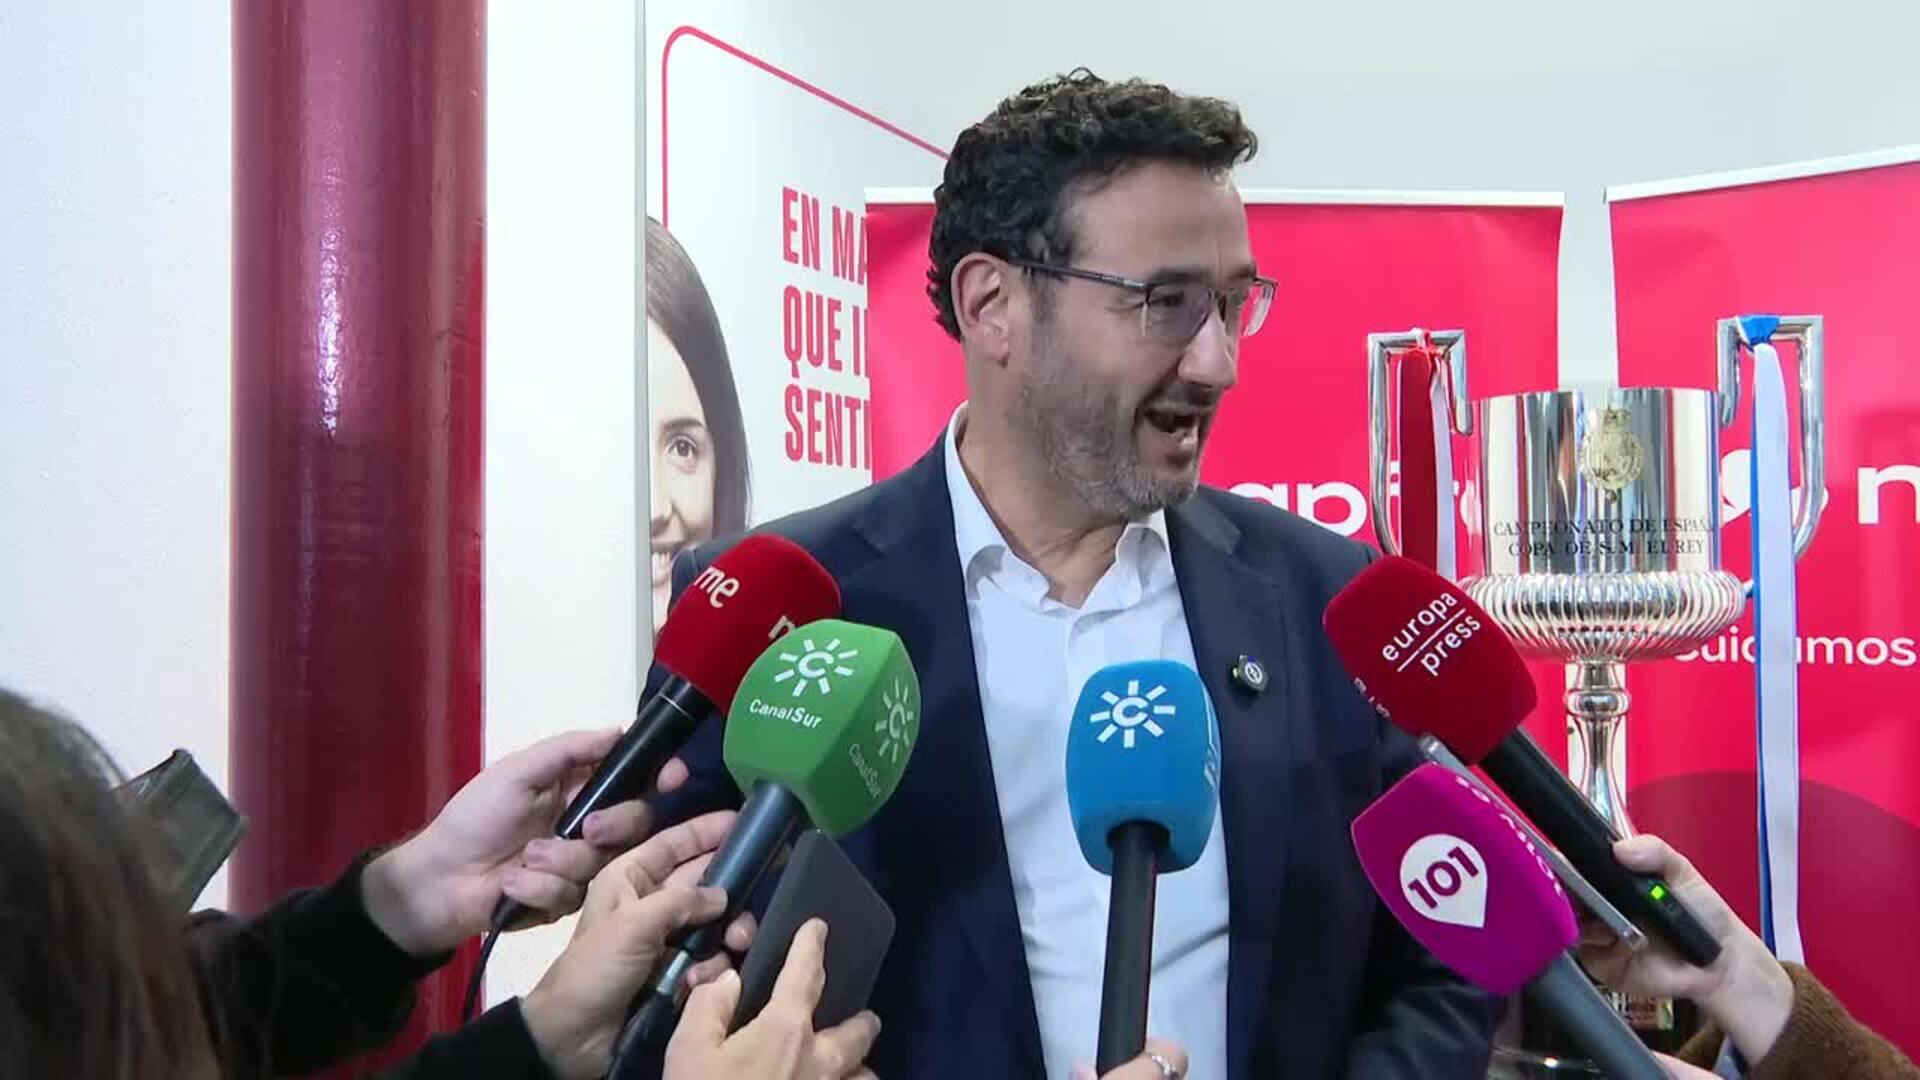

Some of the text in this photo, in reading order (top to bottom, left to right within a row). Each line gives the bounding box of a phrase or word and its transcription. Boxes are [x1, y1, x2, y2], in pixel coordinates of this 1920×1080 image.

[783, 186, 820, 271] EN
[783, 285, 842, 378] QUE
[1493, 519, 1624, 536] CAMPEONATO
[1630, 518, 1657, 533] DE
[1508, 541, 1556, 556] COPA
[1565, 540, 1592, 555] DE
[1676, 540, 1704, 554] REY
[1382, 592, 1458, 661] europa
[1420, 615, 1481, 677] press
[749, 699, 823, 729] CanalSur
[1408, 846, 1479, 909] 101
